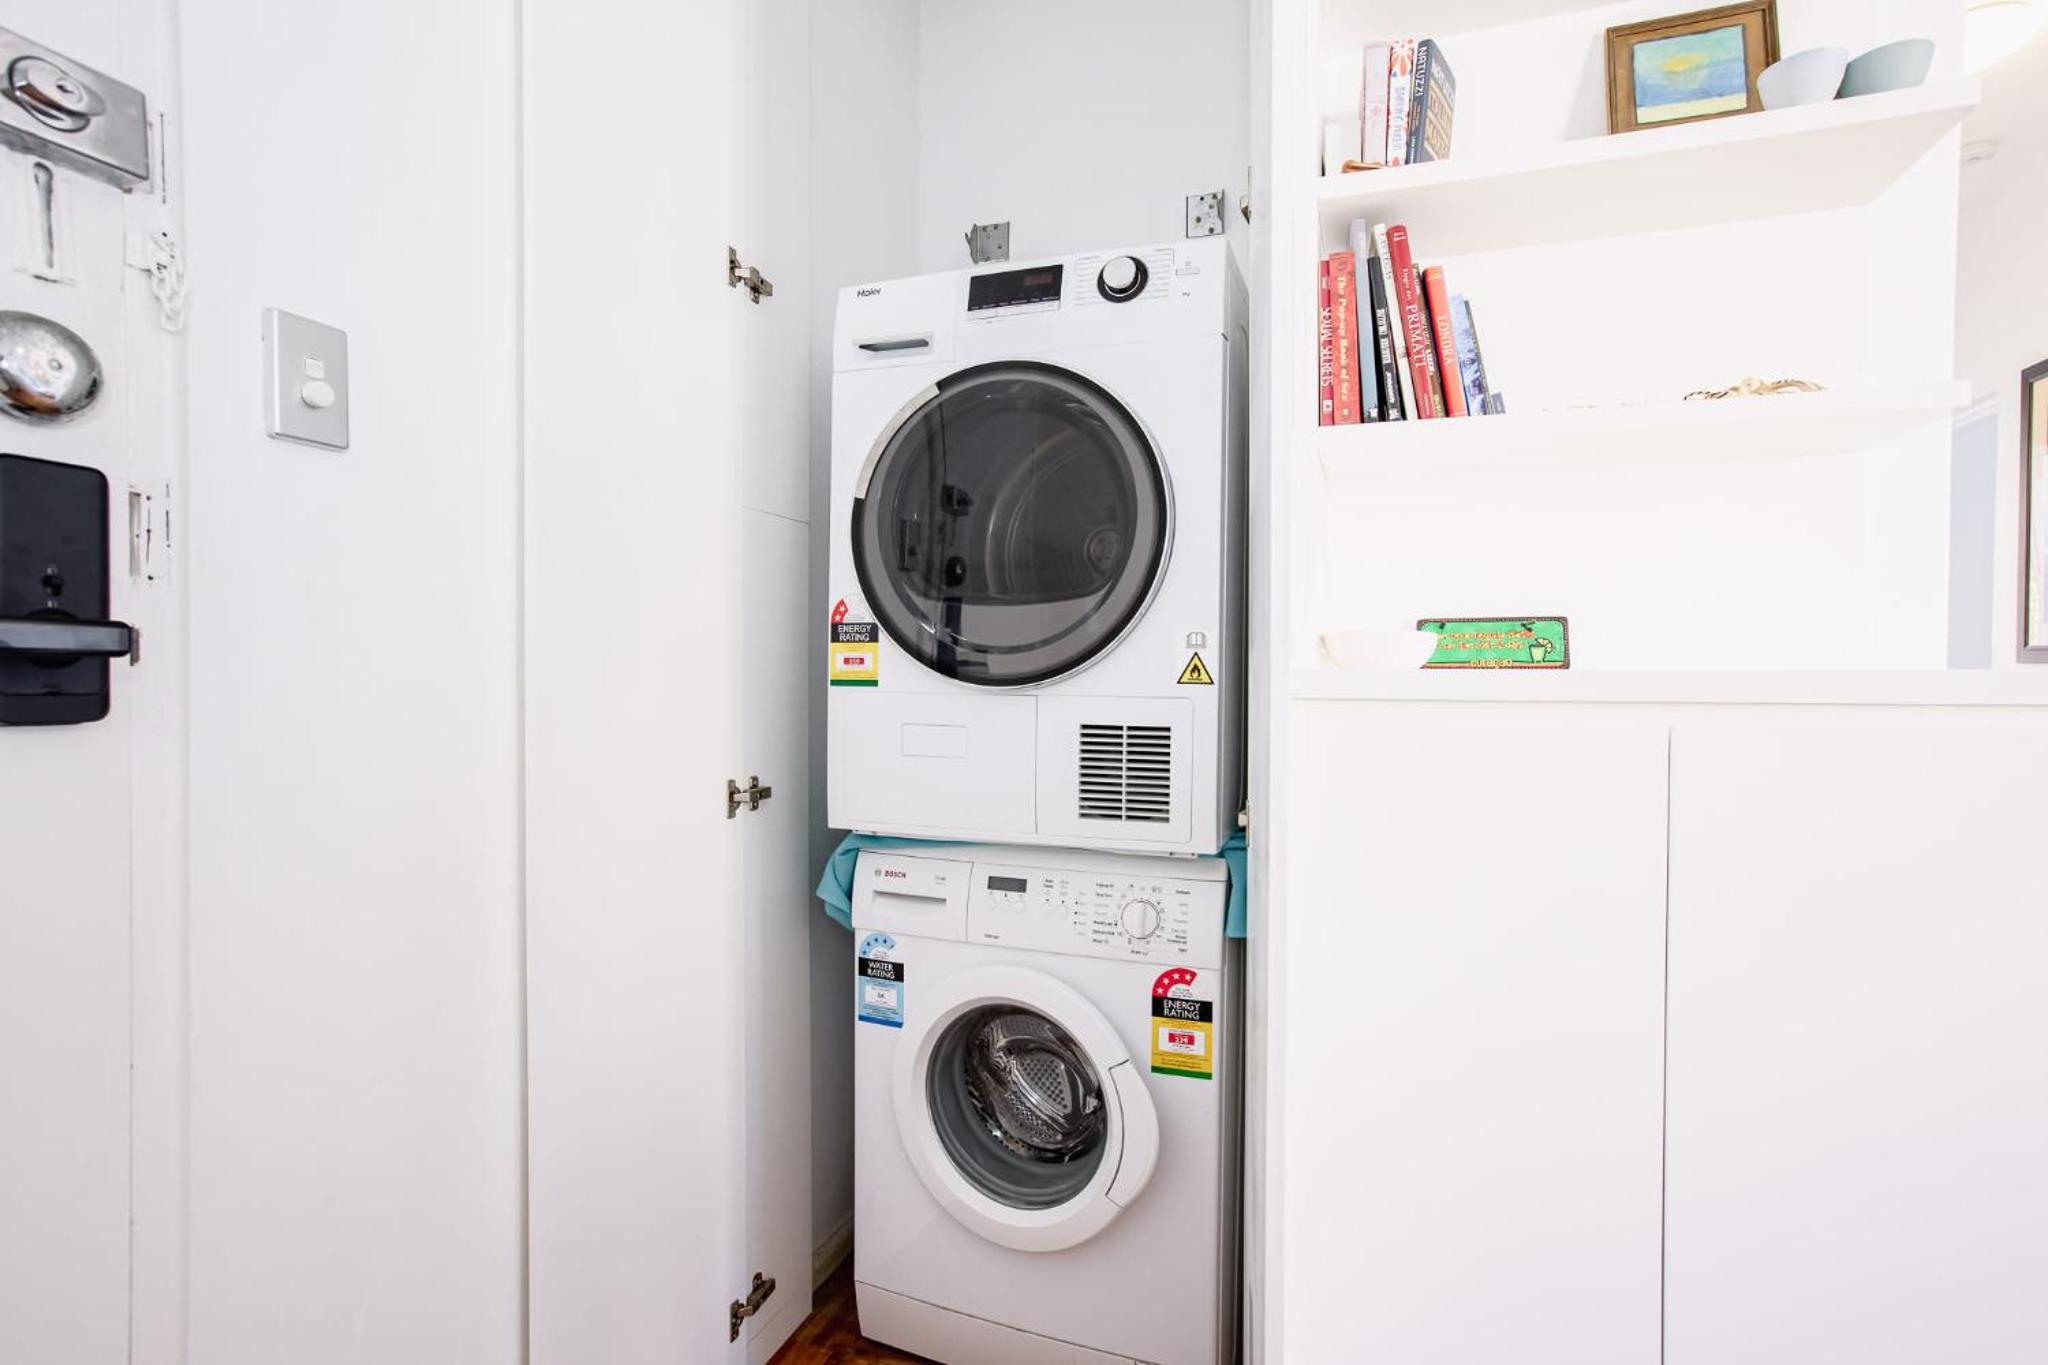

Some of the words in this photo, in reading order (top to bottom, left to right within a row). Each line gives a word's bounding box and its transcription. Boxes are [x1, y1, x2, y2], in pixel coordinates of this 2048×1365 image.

[1415, 46, 1428, 97] NATUZZI
[1337, 276, 1345, 294] The
[857, 287, 882, 298] Haier
[1322, 306, 1332, 344] SEXUAL
[1407, 304, 1426, 368] PRIMATI
[1438, 316, 1454, 368] LONDRA
[1340, 339, 1349, 367] Book
[1322, 345, 1333, 387] SECRETS
[1340, 369, 1349, 381] of
[1341, 382, 1350, 401] Sex
[838, 625, 872, 633] ENERGY
[840, 633, 870, 641] RATING
[884, 870, 907, 879] BOSCH
[868, 961, 894, 972] WATER
[866, 970, 895, 979] RATING
[1163, 999, 1201, 1011] ENERGY
[1163, 1009, 1200, 1020] RATING
